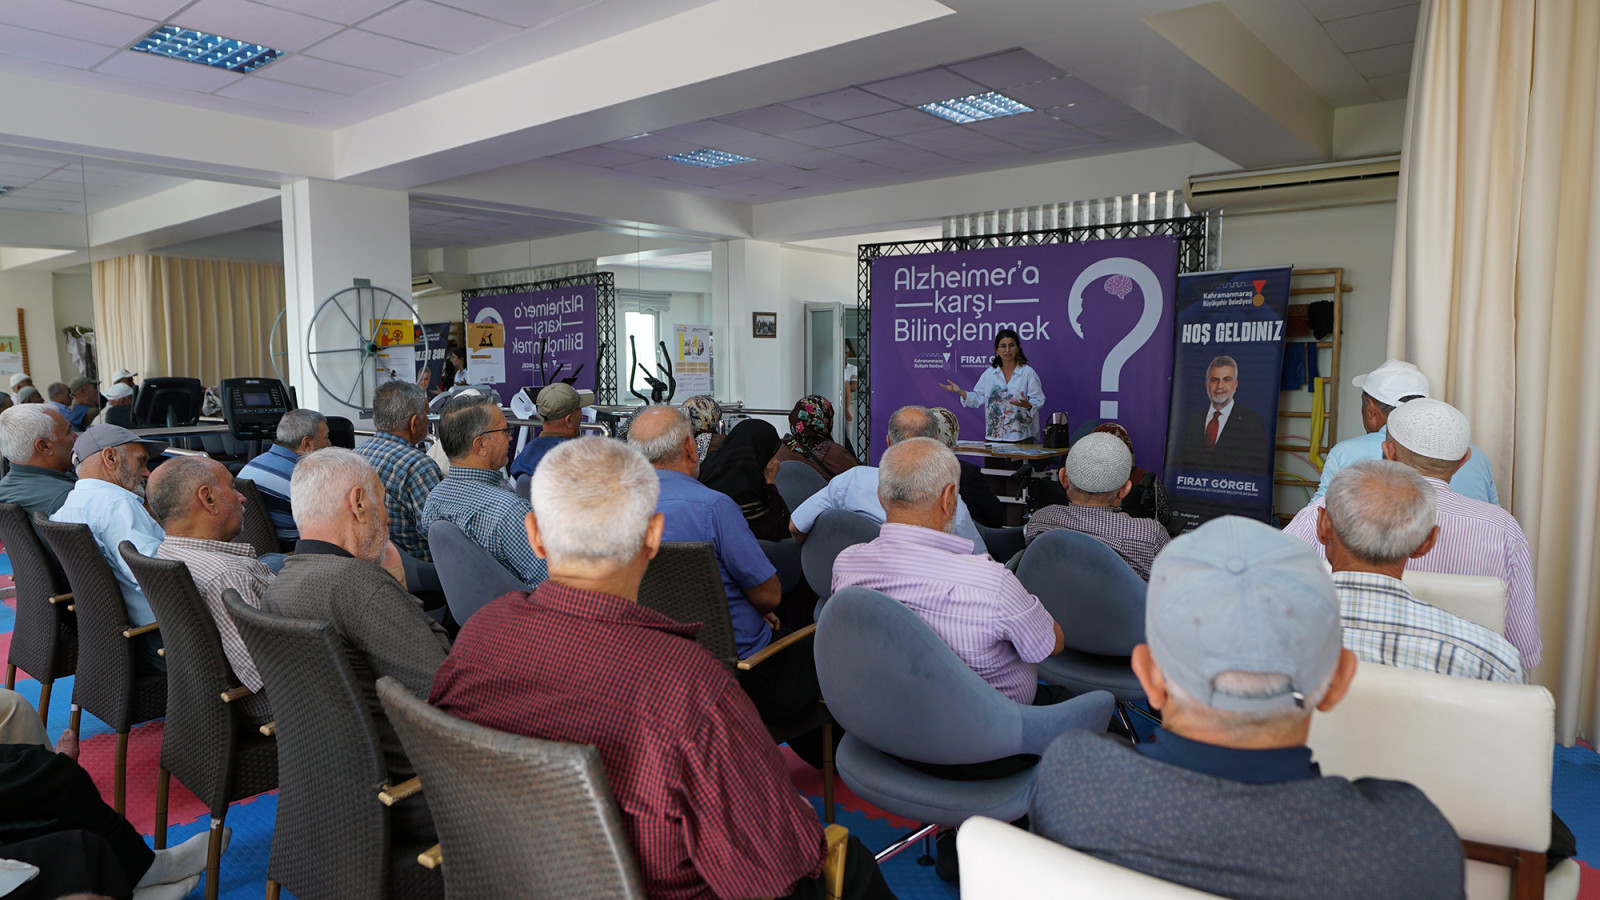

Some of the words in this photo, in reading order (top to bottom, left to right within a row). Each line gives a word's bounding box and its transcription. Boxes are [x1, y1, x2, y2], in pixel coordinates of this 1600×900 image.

[894, 260, 1040, 291] Alzheimer'a
[934, 290, 993, 319] karşı
[894, 315, 1051, 348] Bilinçlenmek
[1182, 323, 1212, 345] HOŞ
[1215, 320, 1284, 343] GELDİNİZ
[960, 355, 988, 364] FIRAT
[1176, 476, 1209, 487] FIRAT
[1211, 478, 1259, 492] GÖRGEL
